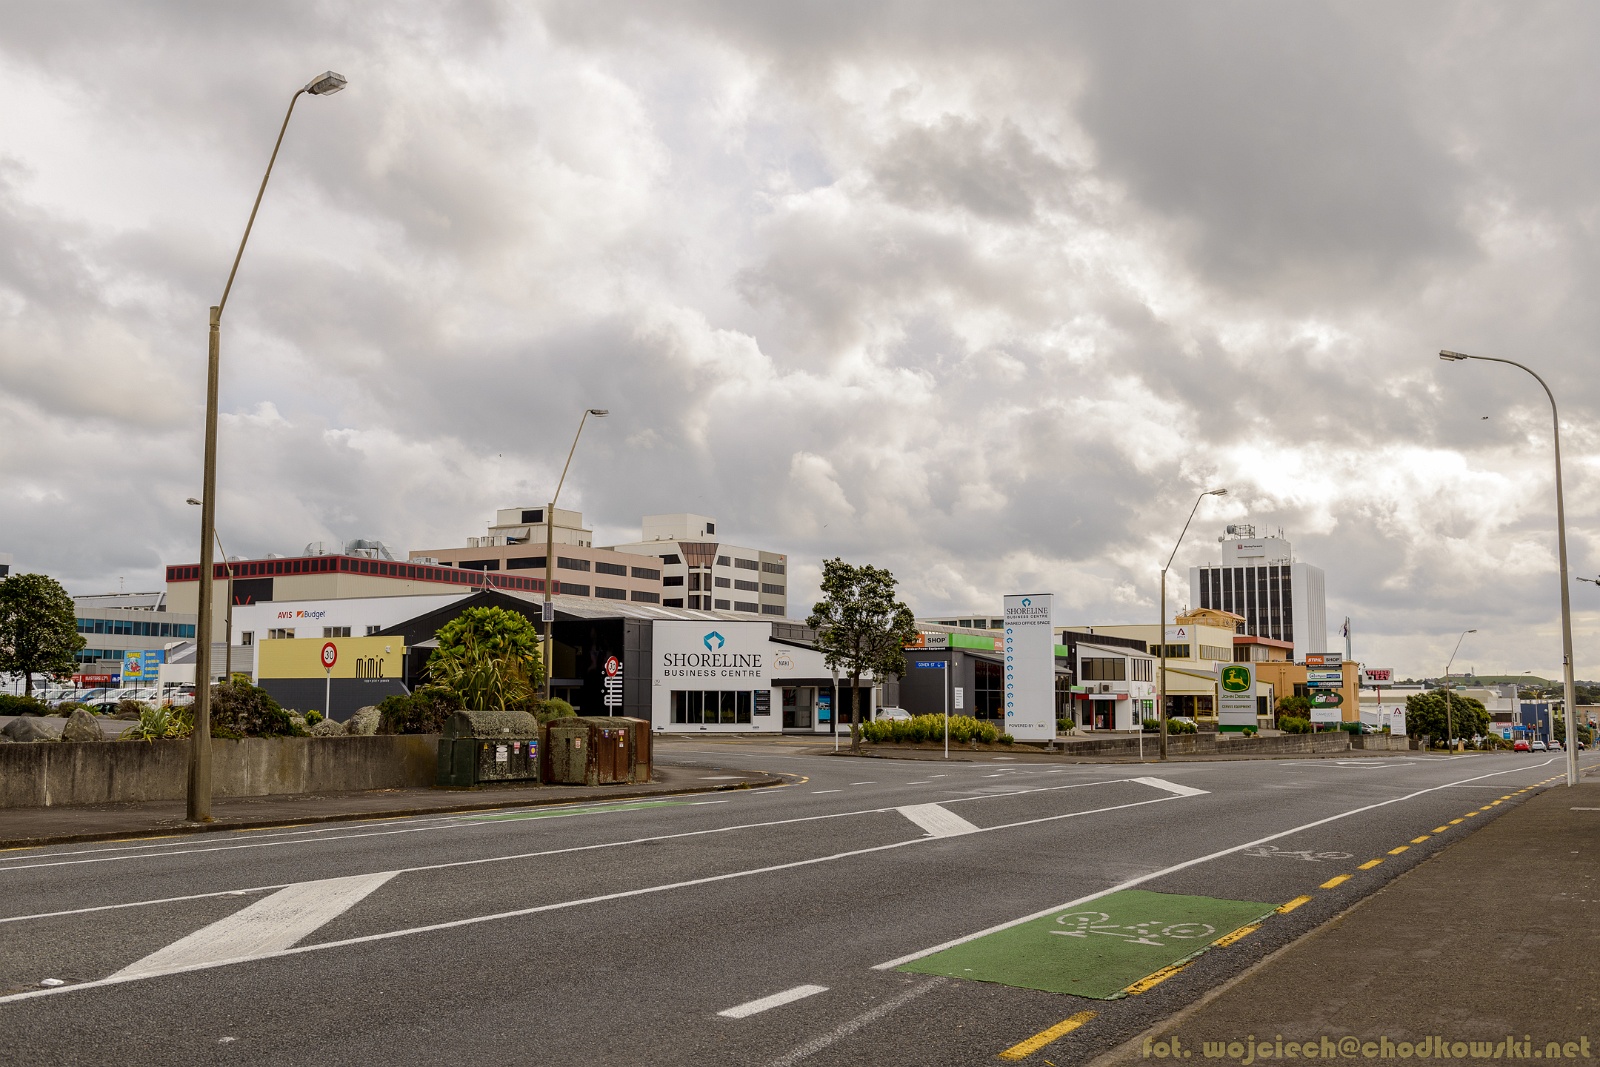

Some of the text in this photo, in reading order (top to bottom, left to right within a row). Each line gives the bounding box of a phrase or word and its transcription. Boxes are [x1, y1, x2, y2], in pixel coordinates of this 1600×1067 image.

[304, 610, 326, 619] Budget
[324, 650, 334, 660] 30
[664, 654, 762, 668] SHORELINE
[356, 654, 384, 678] mimic
